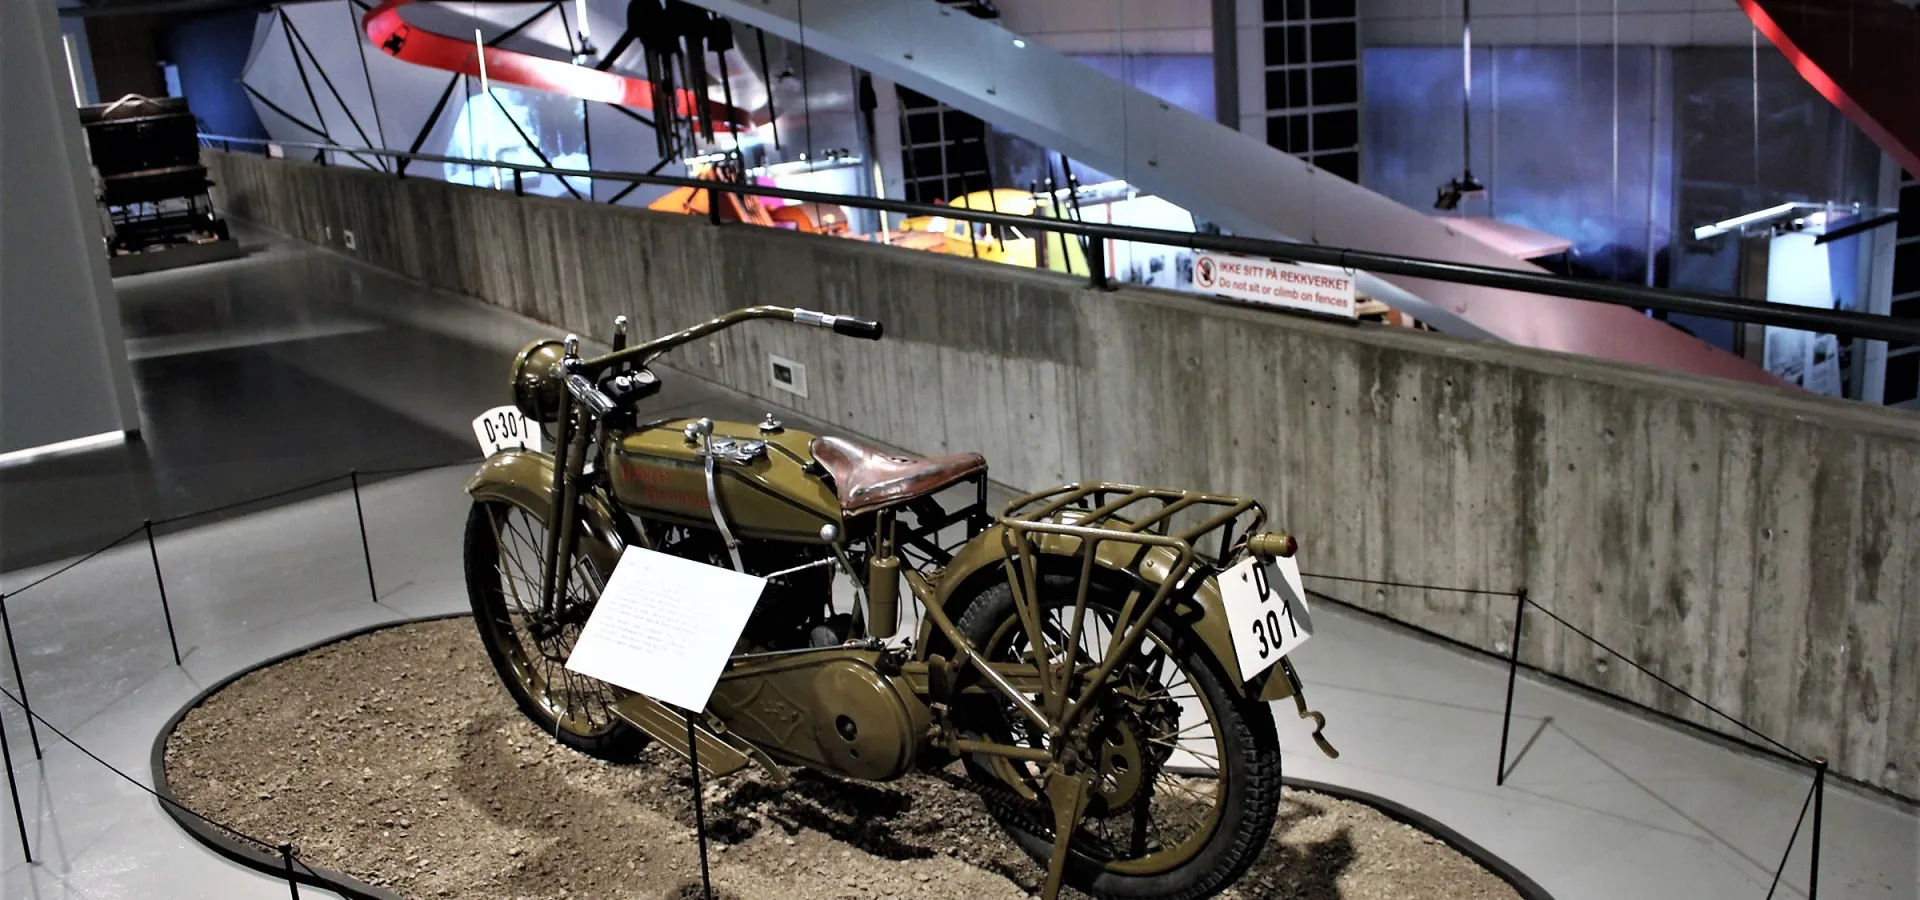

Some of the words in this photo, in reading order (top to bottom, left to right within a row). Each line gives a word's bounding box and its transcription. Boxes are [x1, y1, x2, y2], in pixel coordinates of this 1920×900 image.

[1219, 261, 1241, 274] IKKE
[1243, 264, 1264, 278] SITT
[1266, 266, 1278, 280] PÅ
[1280, 272, 1350, 291] REKKVERKET
[1219, 277, 1231, 289] Do
[1233, 280, 1247, 291] not
[1249, 282, 1260, 293] sit
[1262, 285, 1272, 295] or
[1273, 285, 1299, 299] climb
[1301, 291, 1313, 302] on
[1315, 292, 1348, 308] fences
[1252, 562, 1270, 603] D
[1252, 599, 1297, 659] 301
